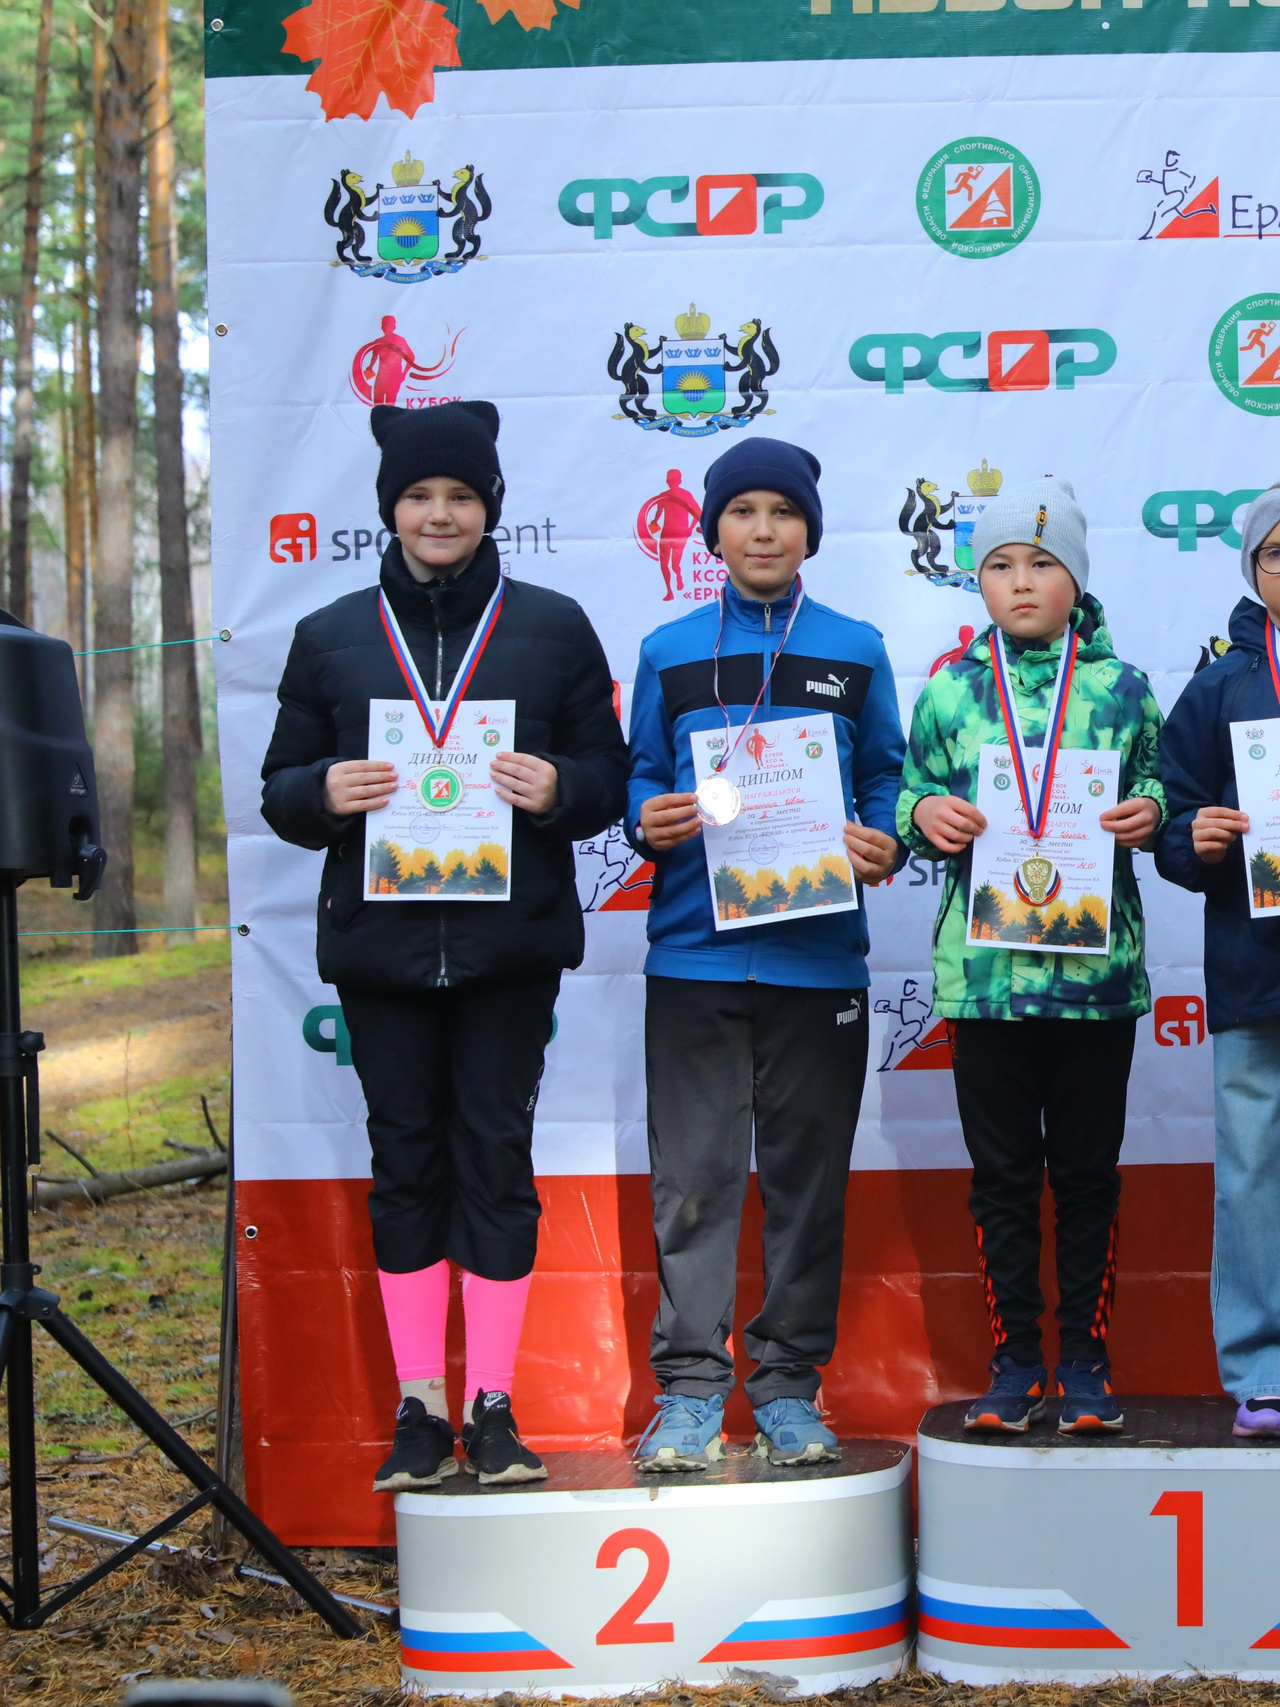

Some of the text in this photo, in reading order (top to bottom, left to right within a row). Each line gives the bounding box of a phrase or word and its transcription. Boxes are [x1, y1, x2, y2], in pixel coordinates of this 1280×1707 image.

[922, 143, 1034, 253] ФЕДЕРАЦИЯ СПОРТИВНОГО ОРИЕНТИРОВАНИЯ ТЮМЕНСКОЙ ОБЛАСТИ
[1215, 310, 1242, 356] ФЕДЕРАЦИЯ
[1216, 362, 1240, 397] ОБЛАСТИ
[806, 680, 840, 698] PUMA
[408, 753, 478, 765] ДИПЛОМ
[736, 768, 803, 788] ДИПЛОМ
[1094, 767, 1113, 775] Ермак
[744, 787, 801, 800] НАГРАЖДАЕТСЯ
[776, 807, 801, 815] место
[837, 1008, 858, 1025] PUMA
[1150, 1491, 1203, 1626] 1
[595, 1528, 674, 1645] 2
